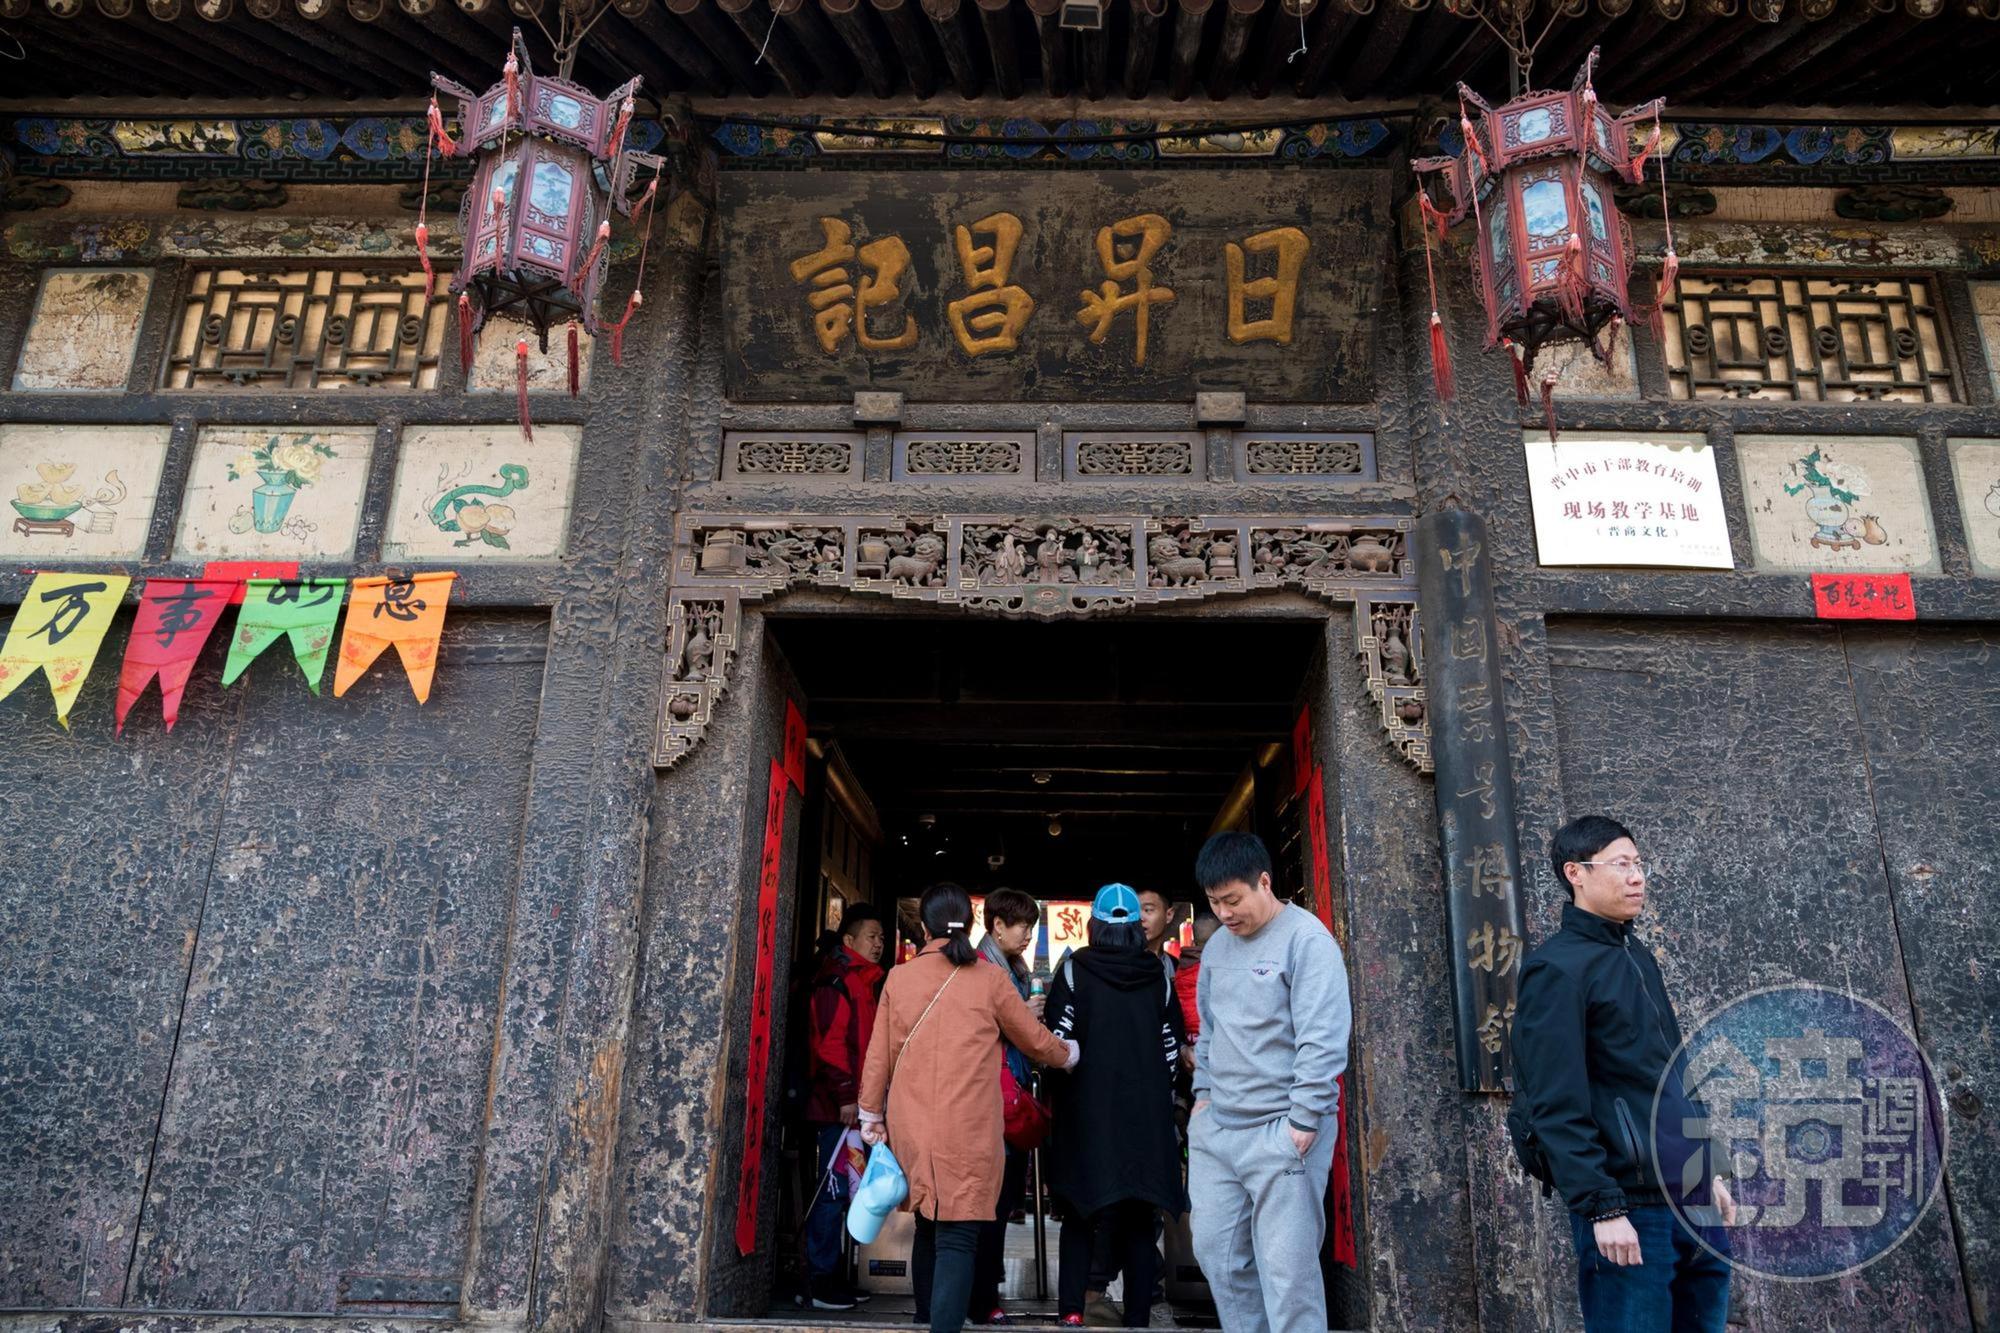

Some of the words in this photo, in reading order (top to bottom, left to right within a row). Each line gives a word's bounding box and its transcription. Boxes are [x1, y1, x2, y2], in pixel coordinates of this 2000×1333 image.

[1563, 500, 1699, 522] 现场教学基地
